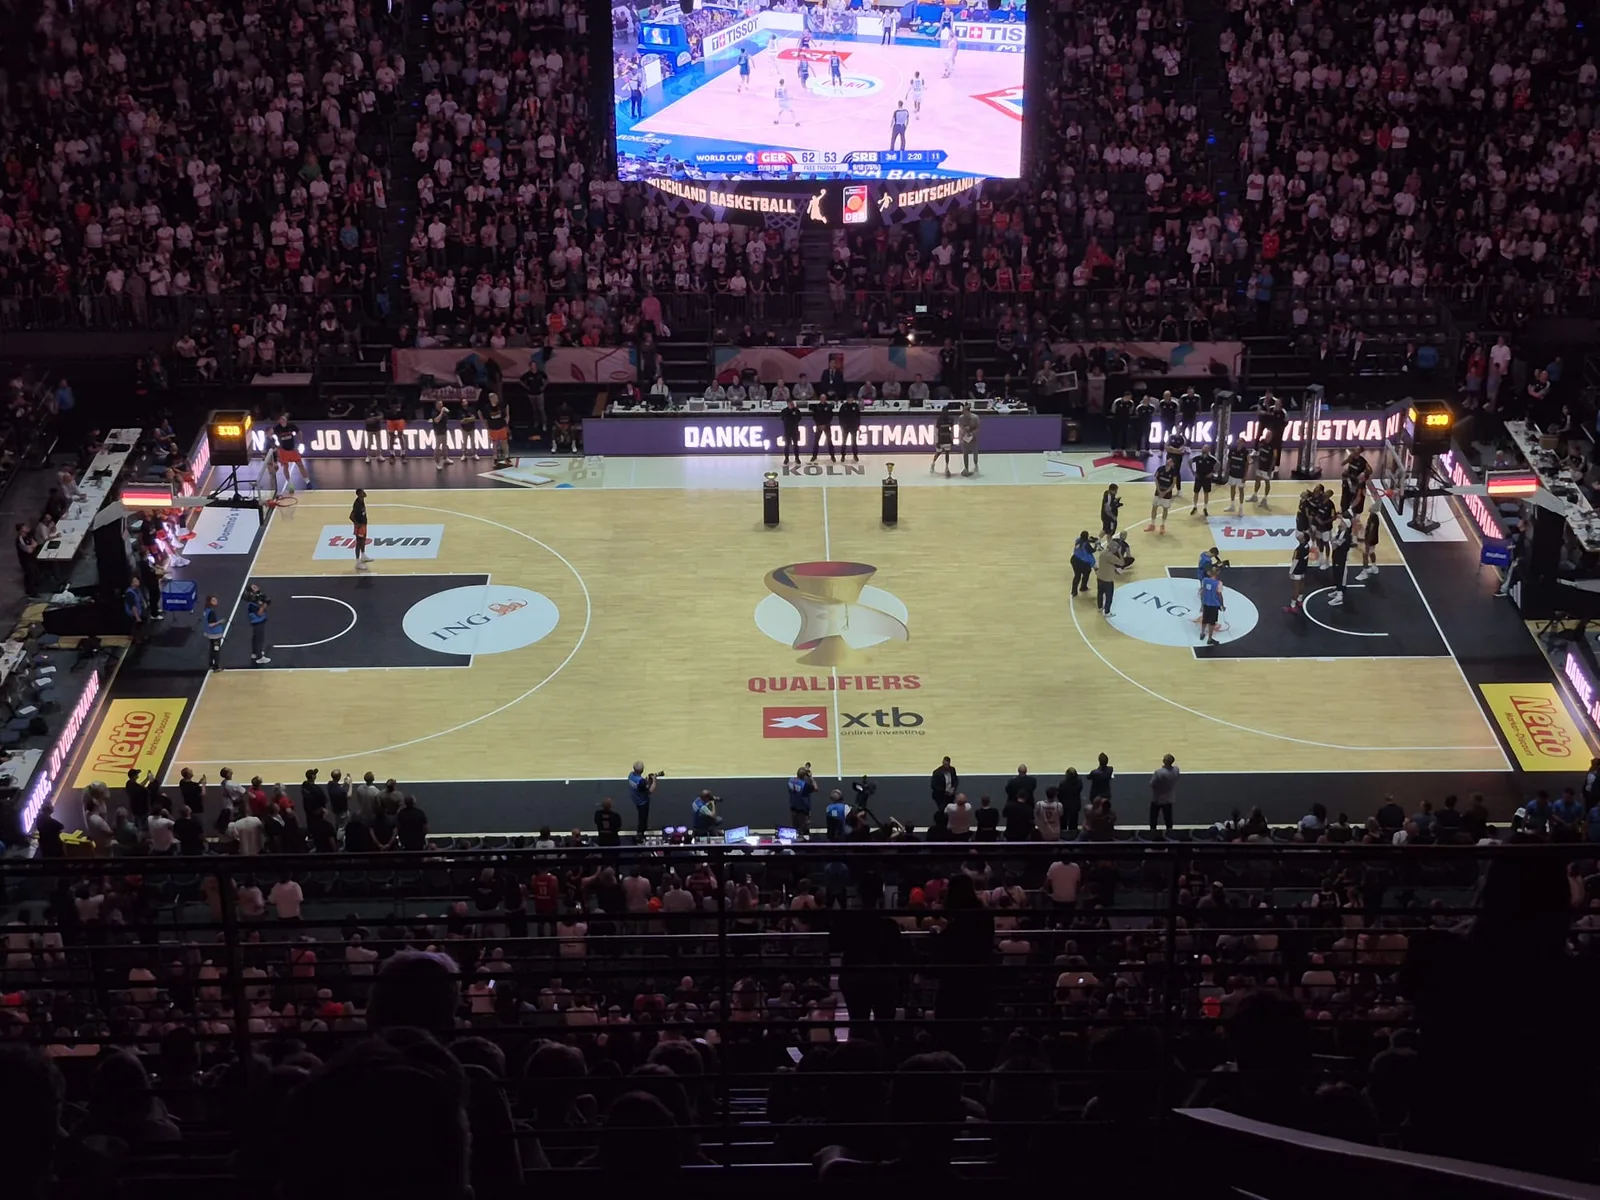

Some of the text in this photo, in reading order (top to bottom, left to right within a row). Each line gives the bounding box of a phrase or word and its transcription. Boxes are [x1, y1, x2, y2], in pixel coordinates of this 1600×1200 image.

[761, 152, 787, 162] GER
[802, 152, 815, 162] 62
[824, 152, 837, 162] 53
[852, 152, 878, 162] SRB
[907, 153, 923, 161] 2:20
[710, 191, 796, 213] BASKETBALL
[899, 178, 974, 207] DEUTSCHLAND
[311, 429, 342, 451] JO
[684, 425, 771, 451] DANKE,
[782, 462, 865, 477] KÖLN
[1221, 526, 1296, 540] tipw
[1132, 591, 1191, 618] ING
[430, 613, 492, 641] ING
[748, 675, 922, 693] QUALIFIERS
[1565, 653, 1592, 714] DANKE,
[840, 706, 924, 728] xtb
[1510, 695, 1571, 757] Netto
[22, 669, 100, 833] DANKE, JO VOIGTMANN!
[92, 710, 156, 774] Netto
